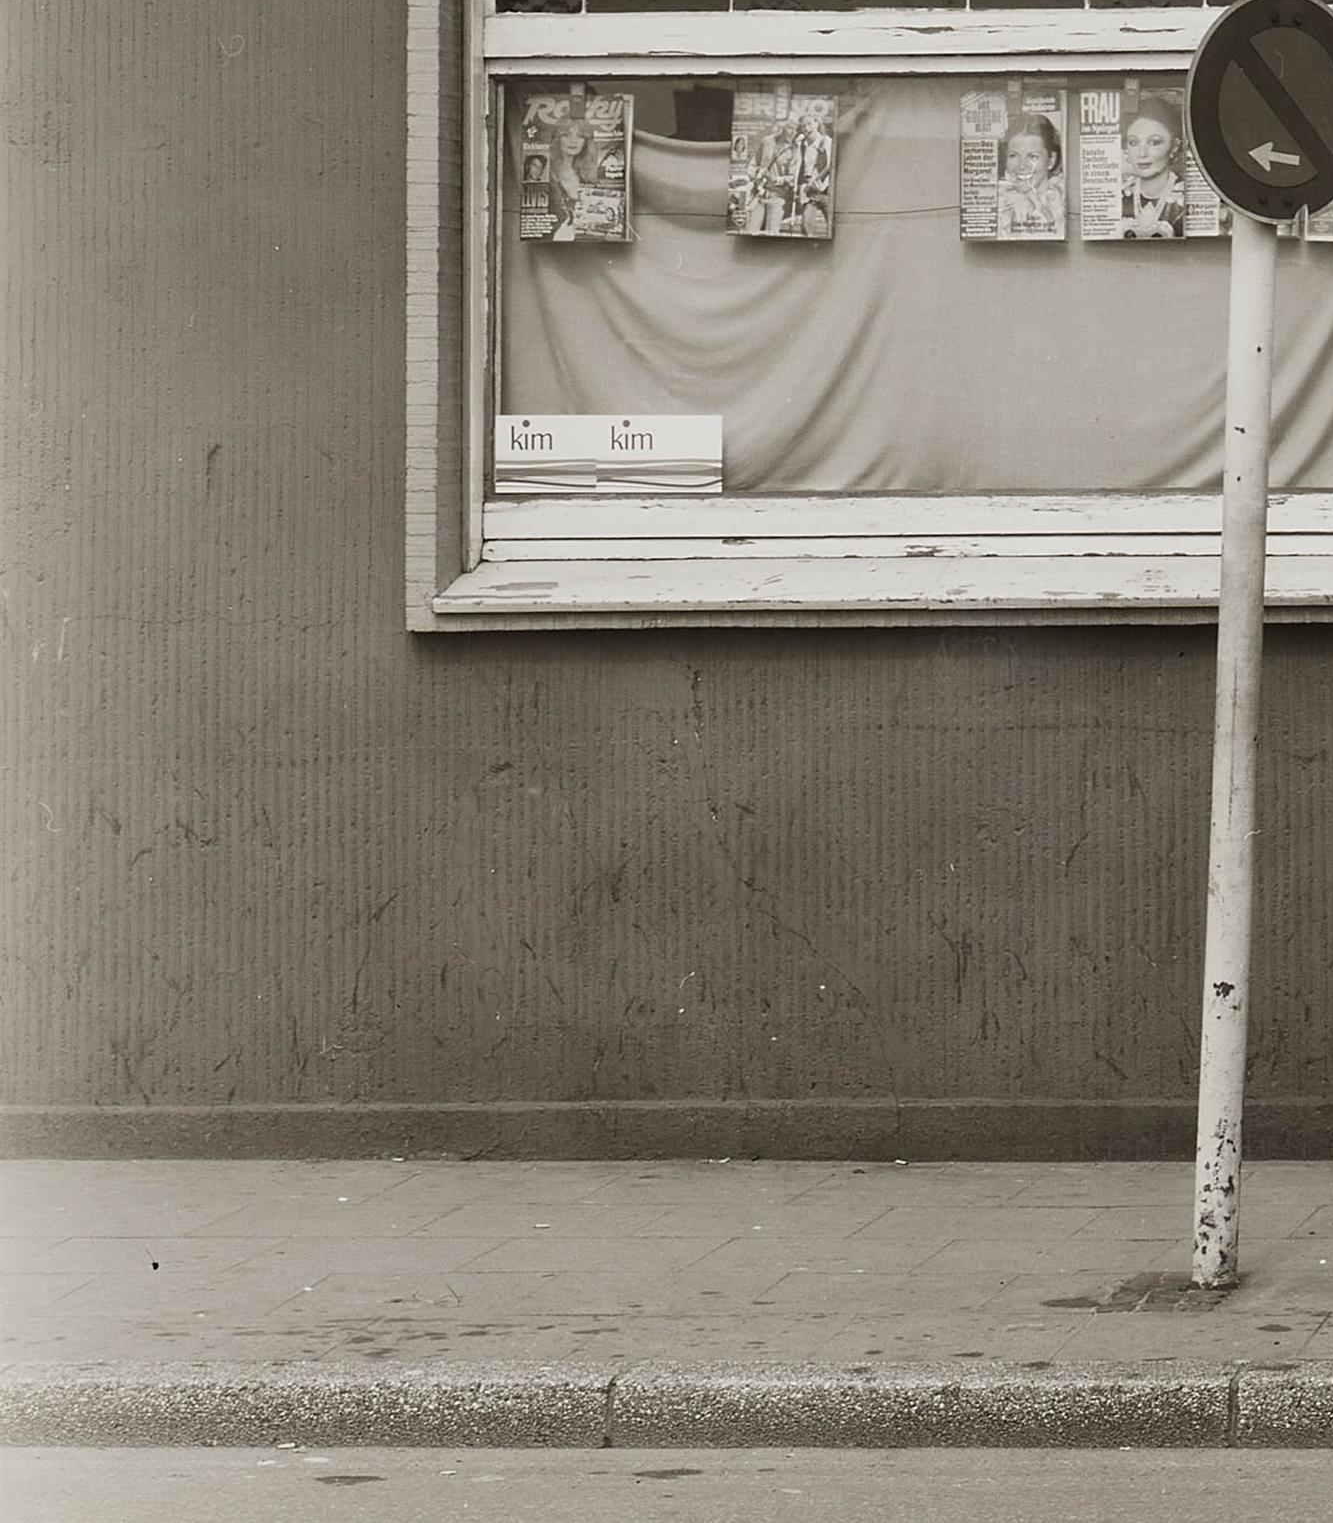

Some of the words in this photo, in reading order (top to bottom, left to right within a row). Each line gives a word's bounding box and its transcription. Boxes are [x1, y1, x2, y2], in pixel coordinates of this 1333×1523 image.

[522, 93, 625, 131] Roky
[733, 98, 830, 117] BRVO
[1080, 92, 1120, 124] FRAU
[511, 419, 553, 450] kim
[611, 419, 654, 450] kim
